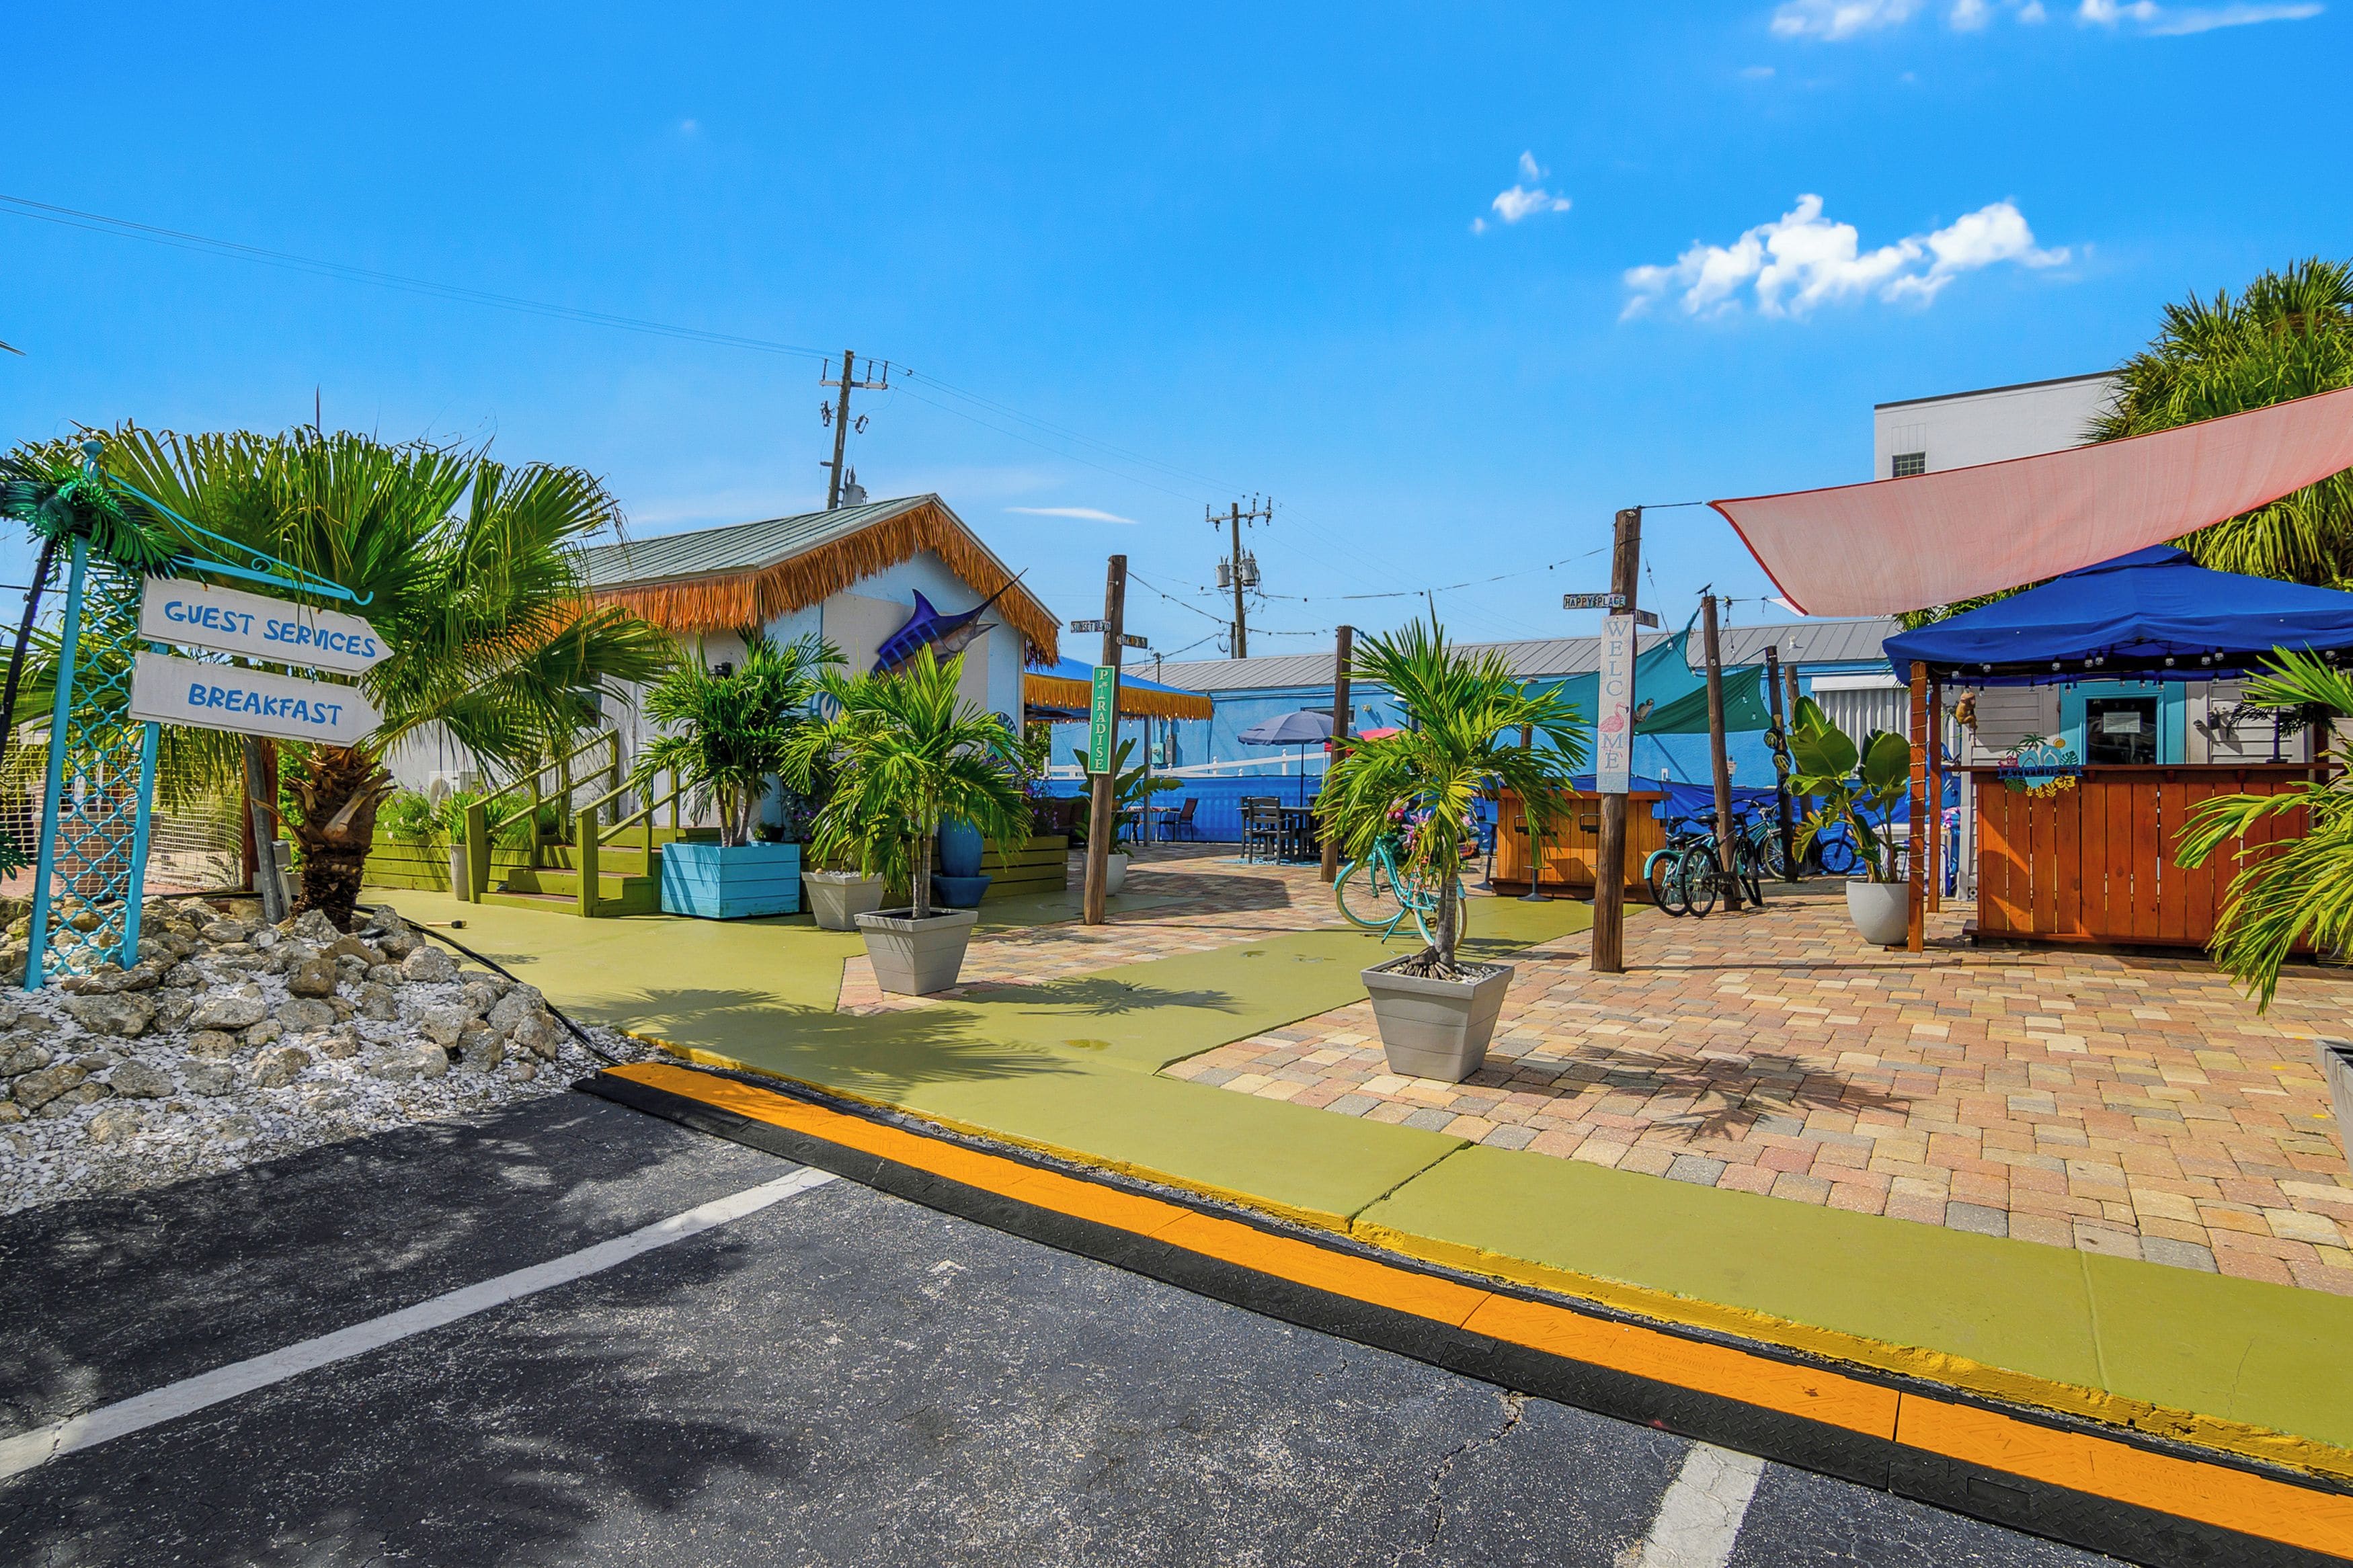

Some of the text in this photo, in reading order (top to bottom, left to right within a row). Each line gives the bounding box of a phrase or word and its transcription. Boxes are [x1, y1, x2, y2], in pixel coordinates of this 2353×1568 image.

[1565, 595, 1625, 608] HAPPY PLACE
[164, 601, 376, 657] GUEST SERVICES
[1072, 622, 1093, 632] SUNSET
[188, 683, 343, 726] BREAKFAST
[1094, 669, 1108, 769] PRADISE
[1601, 621, 1630, 769] WELCME
